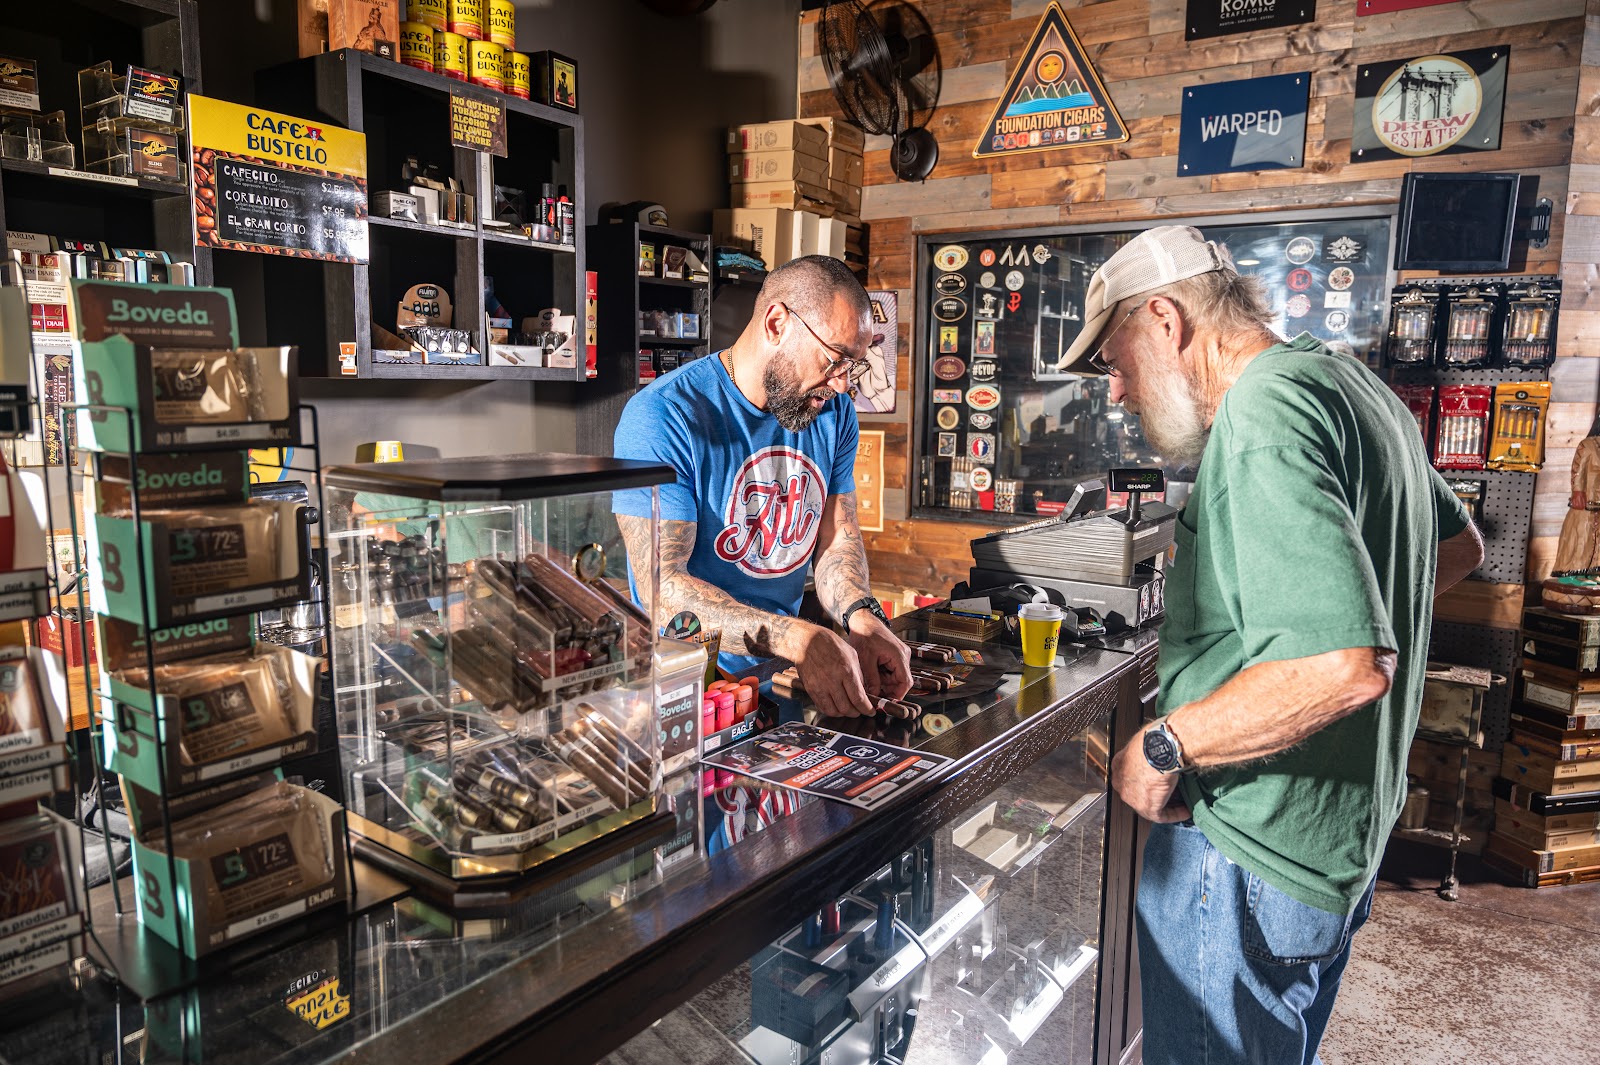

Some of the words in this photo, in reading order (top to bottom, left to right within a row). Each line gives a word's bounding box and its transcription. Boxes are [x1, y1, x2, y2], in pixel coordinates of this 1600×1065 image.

[1220, 10, 1244, 19] CRAFT
[1247, 5, 1274, 14] TOBAC
[452, 96, 464, 106] NO
[466, 100, 500, 115] OUTSIDE
[453, 106, 489, 120] TOBACCO
[247, 113, 304, 139] CAFÉ
[453, 114, 489, 129] ALCOHOL
[995, 113, 1062, 134] FOUNDATION
[1064, 107, 1105, 127] CIGARS
[1201, 110, 1282, 143] WARPED
[1382, 111, 1475, 134] DREW
[454, 123, 492, 138] ALLOWED
[454, 131, 463, 140] IN
[466, 134, 491, 146] STORE
[1390, 127, 1458, 149] ESTATE
[247, 134, 327, 165] BUSTELO
[224, 165, 278, 183] CAFECITO
[225, 190, 288, 208] CORTADITO
[228, 214, 242, 226] EL
[244, 217, 271, 230] GRAN
[274, 222, 305, 234] CORTO
[985, 254, 992, 263] W
[106, 299, 209, 325] Boveda
[972, 364, 995, 375] #CYOP
[857, 440, 872, 456] FÉ
[562, 674, 577, 684] NEW
[578, 668, 604, 680] RELEASE
[660, 699, 691, 718] Boveda
[732, 721, 753, 738] EAGLE
[0, 736, 32, 749] oking
[0, 751, 51, 769] product
[800, 751, 835, 768] CONES
[0, 773, 49, 790] ddictive
[258, 842, 286, 865] 72%
[308, 887, 336, 907] ENJOY.
